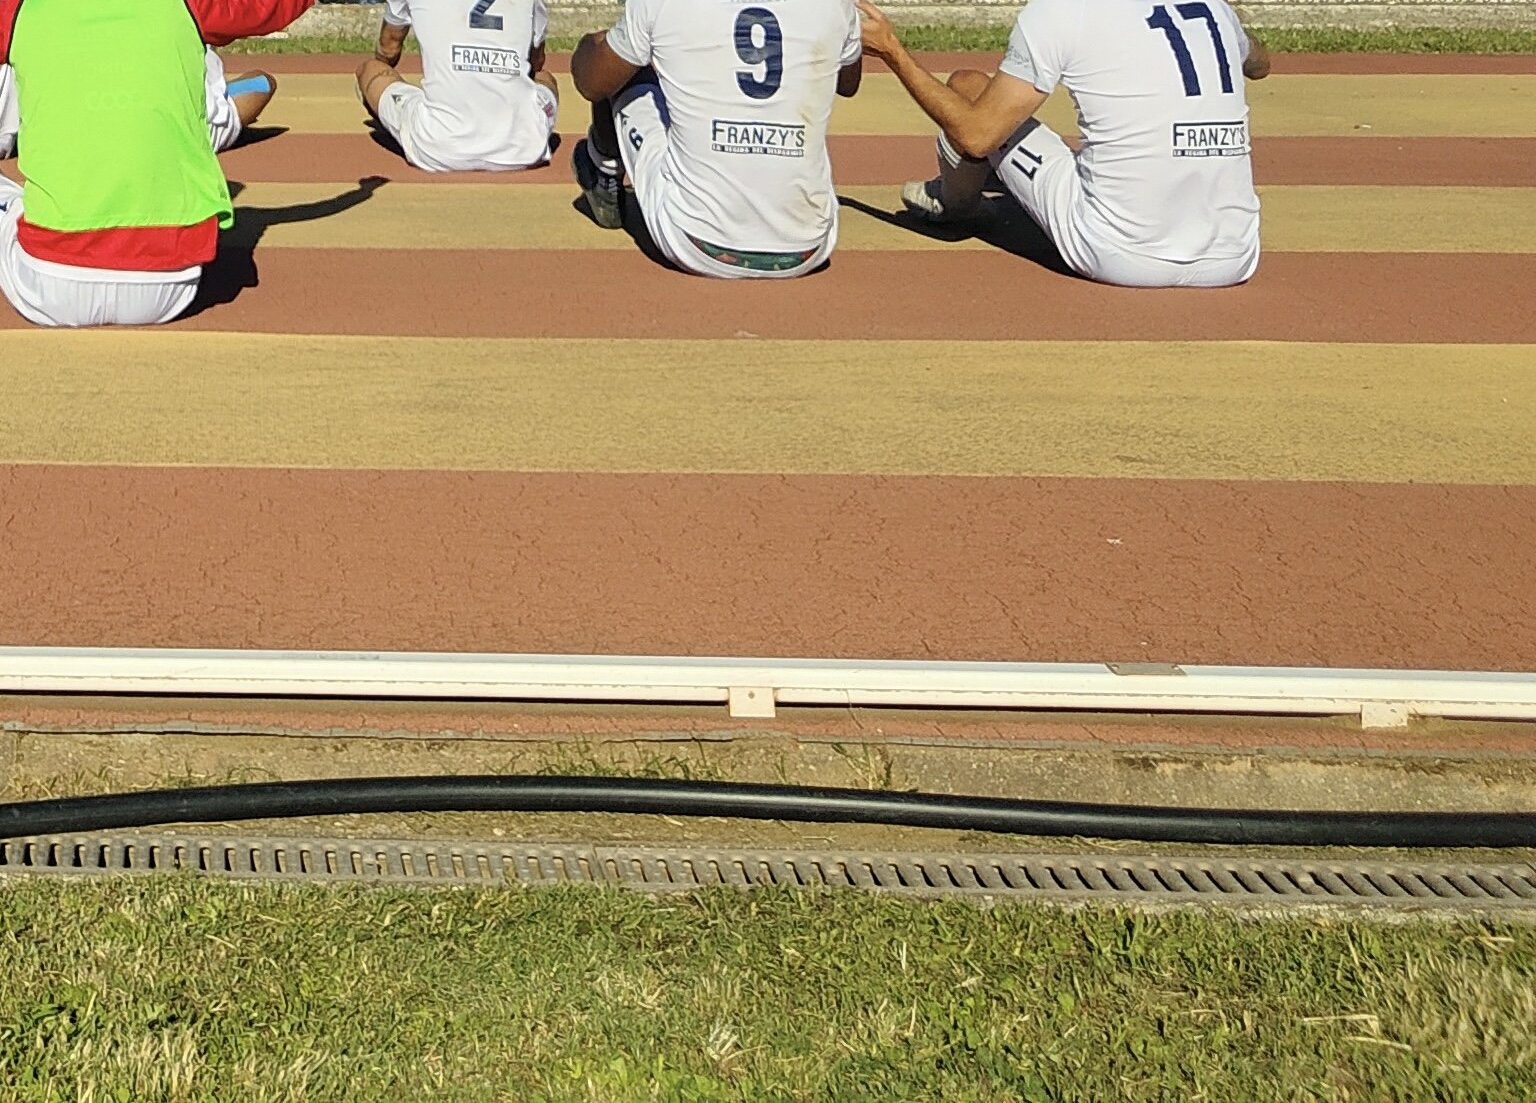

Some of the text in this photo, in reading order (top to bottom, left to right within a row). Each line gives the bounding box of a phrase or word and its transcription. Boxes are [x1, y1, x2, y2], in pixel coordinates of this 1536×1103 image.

[452, 45, 520, 69] FRANZY'S
[734, 7, 783, 99] 9
[1145, 2, 1234, 96] 17
[712, 119, 805, 148] FRANZY'S
[1173, 121, 1245, 147] FRANZY'S
